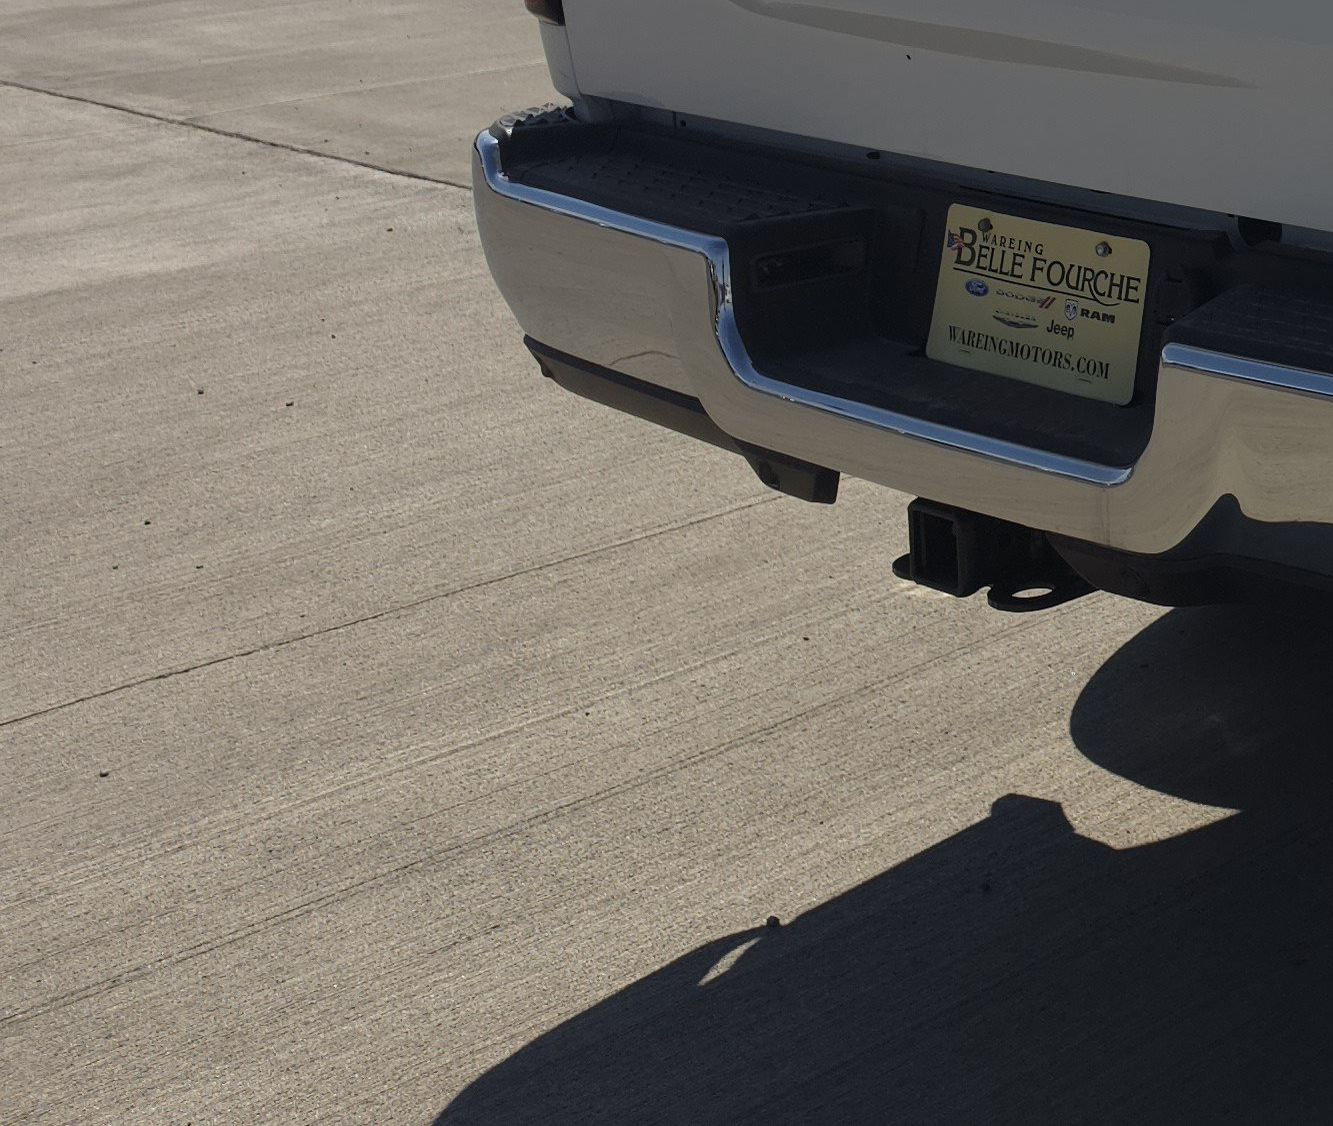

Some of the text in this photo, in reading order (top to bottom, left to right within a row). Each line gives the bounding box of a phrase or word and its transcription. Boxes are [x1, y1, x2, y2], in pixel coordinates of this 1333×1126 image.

[981, 231, 1045, 255] WAREING
[954, 226, 1142, 306] BELLE FOURCHE
[1080, 308, 1116, 324] RAM
[1046, 319, 1075, 340] Jeep
[948, 324, 1110, 380] WAREINGMOTORS.COM
